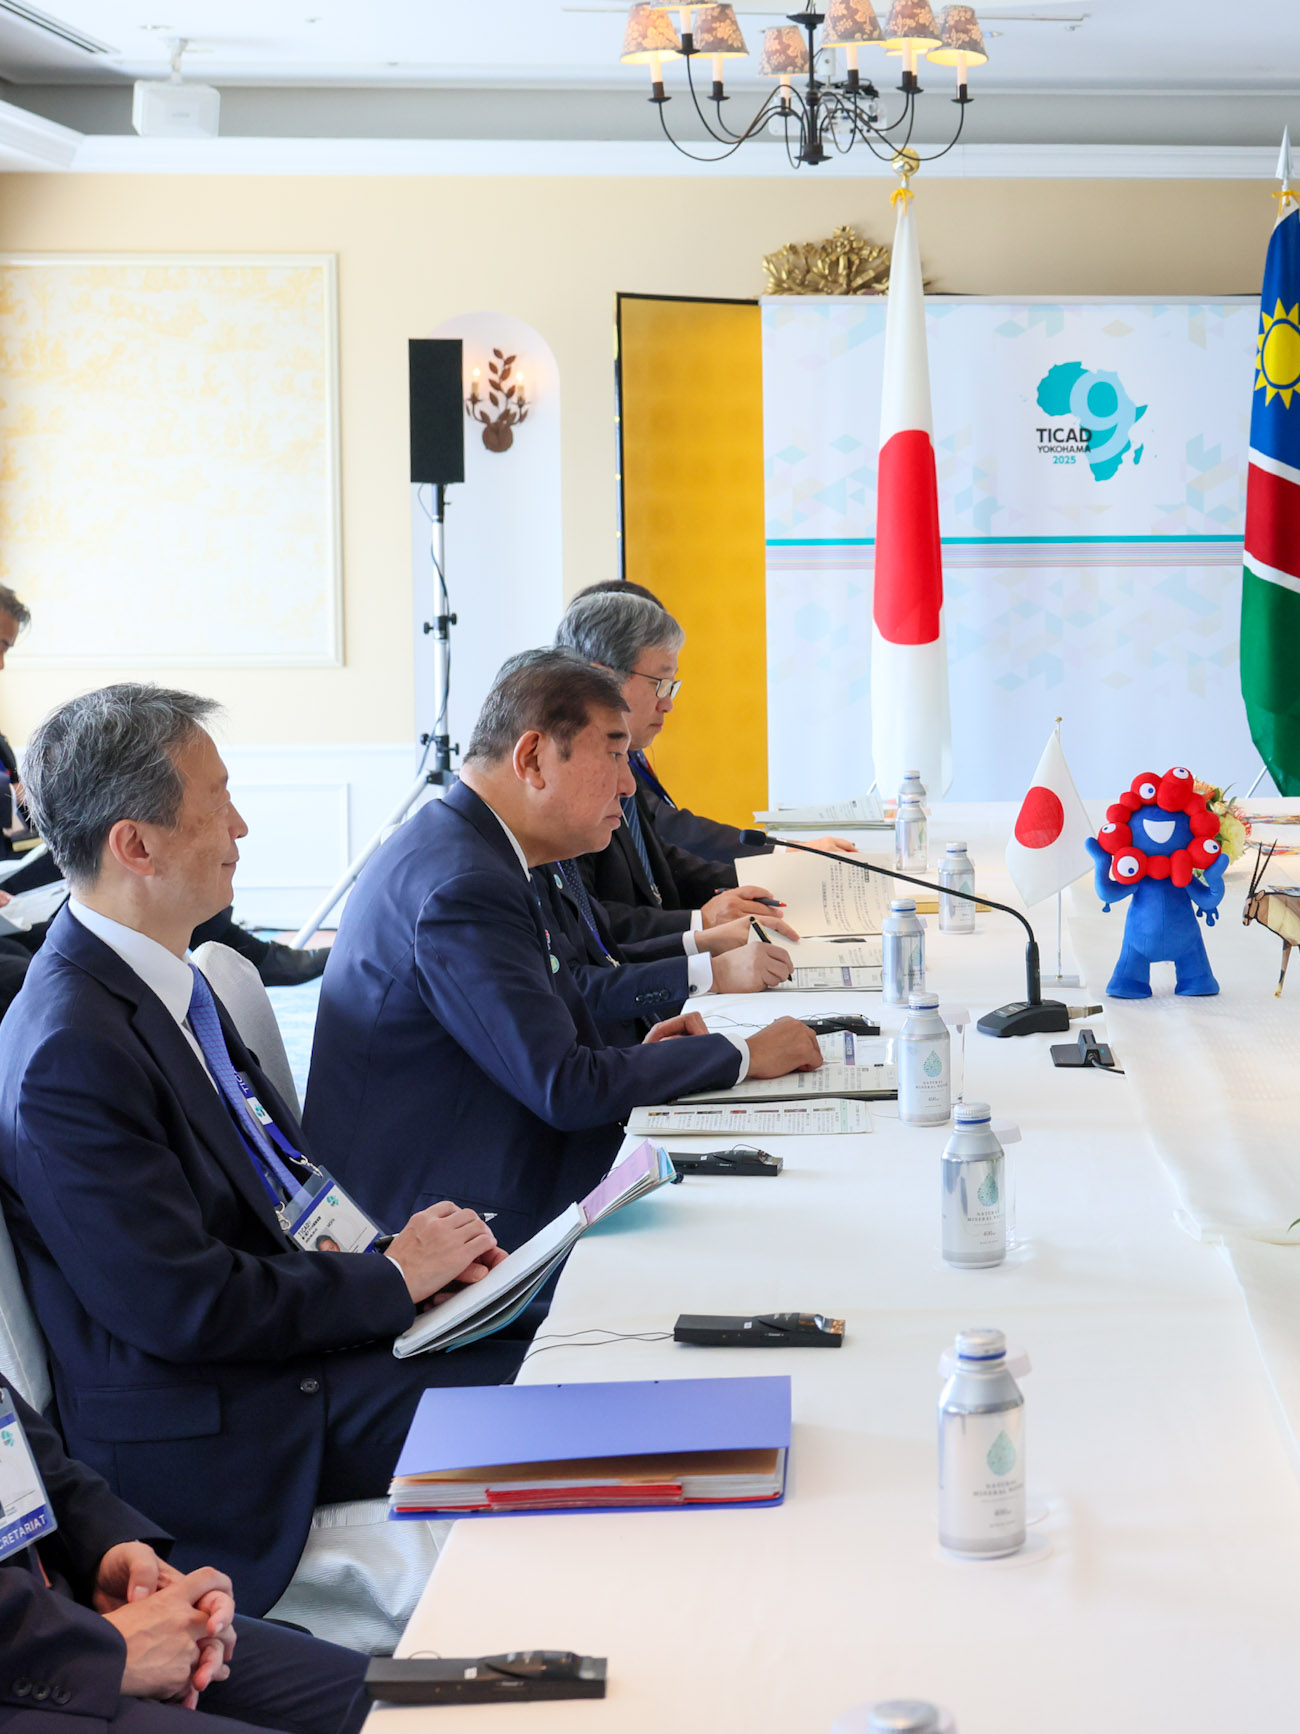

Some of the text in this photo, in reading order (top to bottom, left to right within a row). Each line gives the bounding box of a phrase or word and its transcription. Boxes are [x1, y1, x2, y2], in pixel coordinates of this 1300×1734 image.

[1036, 428, 1092, 443] TICAD
[1037, 445, 1091, 453] YOKOHAMA
[1053, 456, 1076, 464] 2025
